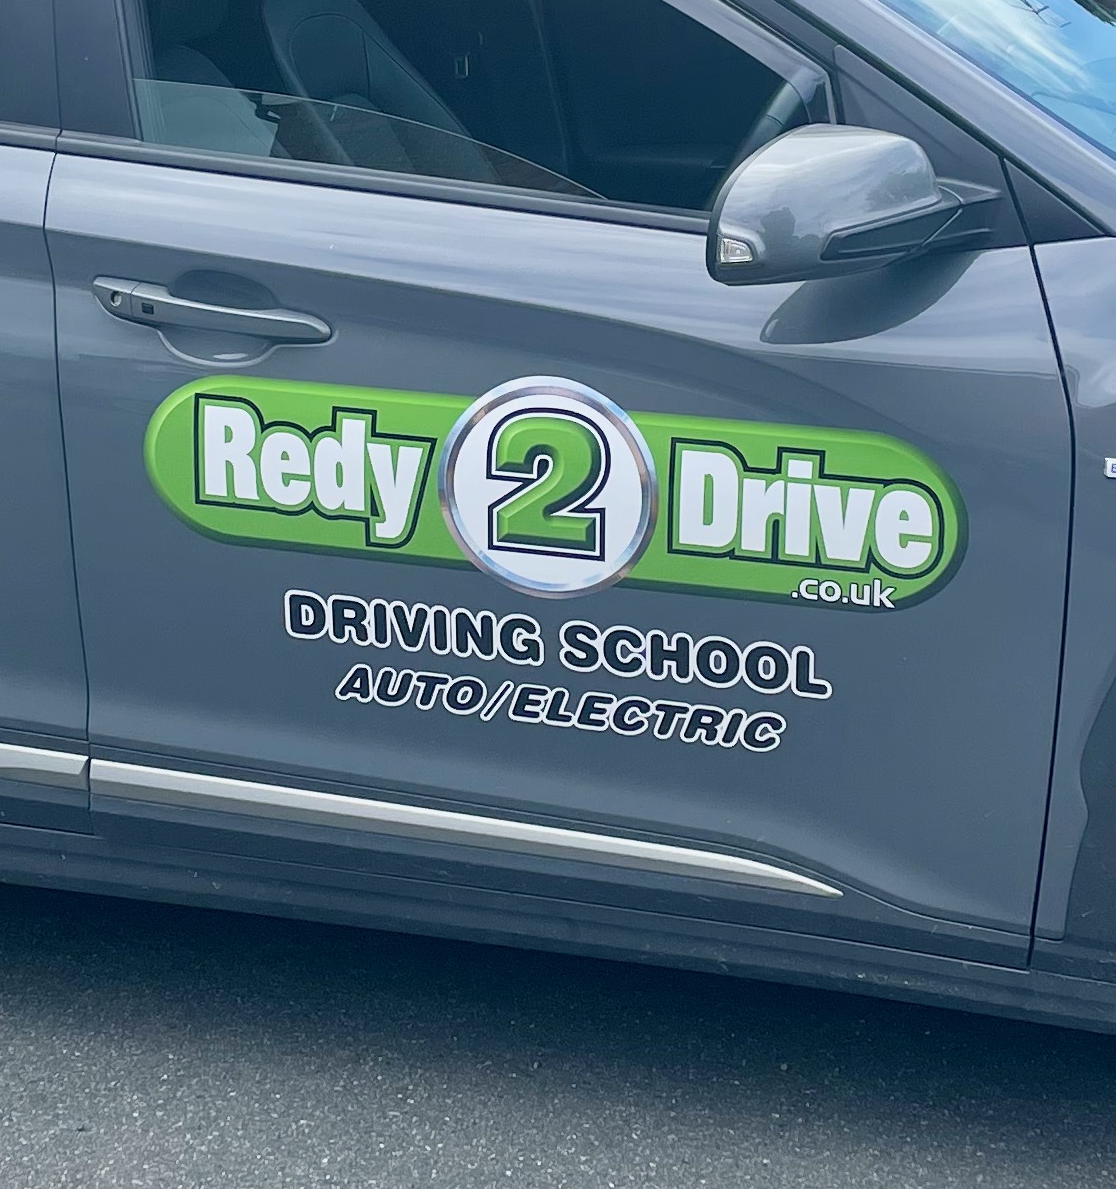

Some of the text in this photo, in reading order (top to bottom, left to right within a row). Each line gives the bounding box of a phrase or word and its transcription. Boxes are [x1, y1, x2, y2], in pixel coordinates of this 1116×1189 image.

[198, 398, 941, 575] Redy 2 Drive
[790, 577, 896, 608] .co.uk
[284, 589, 833, 700] DRIVING SCHOOL
[336, 663, 788, 753] AUTO/ELECTRIC
